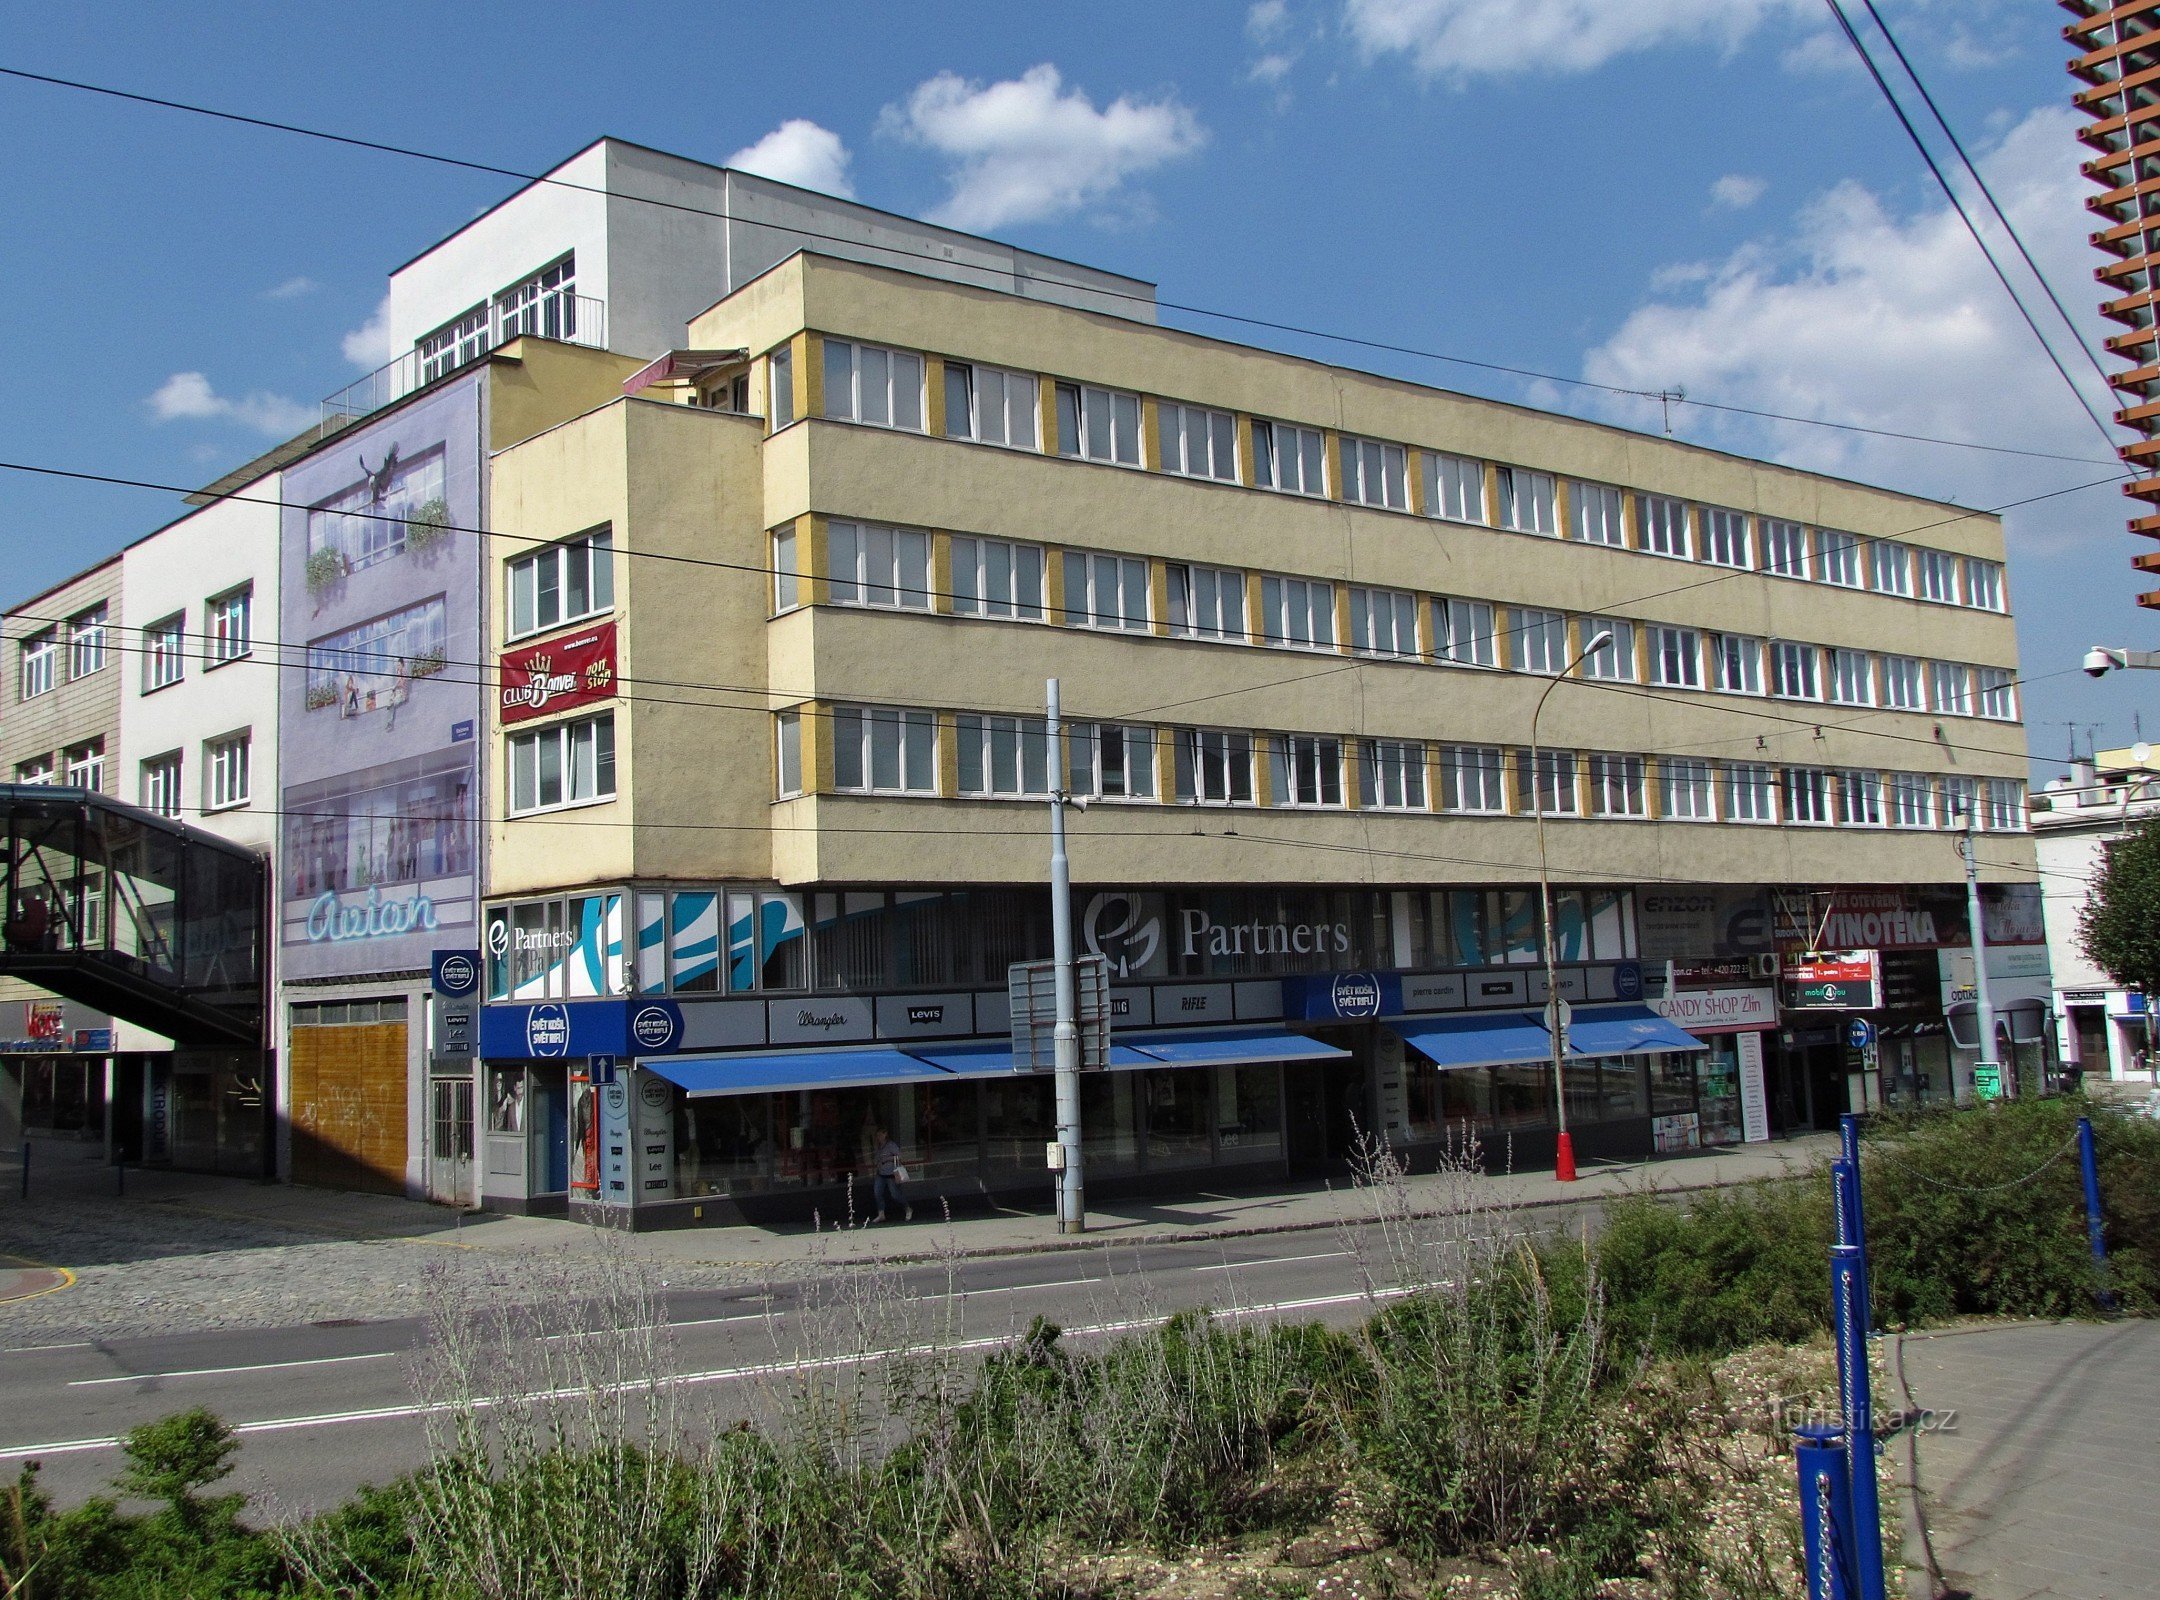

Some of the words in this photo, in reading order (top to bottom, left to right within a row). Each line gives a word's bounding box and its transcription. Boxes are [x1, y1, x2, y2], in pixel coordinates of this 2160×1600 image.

[503, 684, 532, 705] CLUB
[529, 672, 577, 708] Bonver
[1179, 908, 1349, 956] Partners
[1821, 907, 1938, 947] VINOTÉKA
[514, 928, 573, 950] Partners
[1181, 996, 1207, 1010] RIFLE
[1659, 999, 1702, 1018] CANDY
[1704, 997, 1739, 1016] SHOP
[796, 1010, 848, 1031] Wrangler
